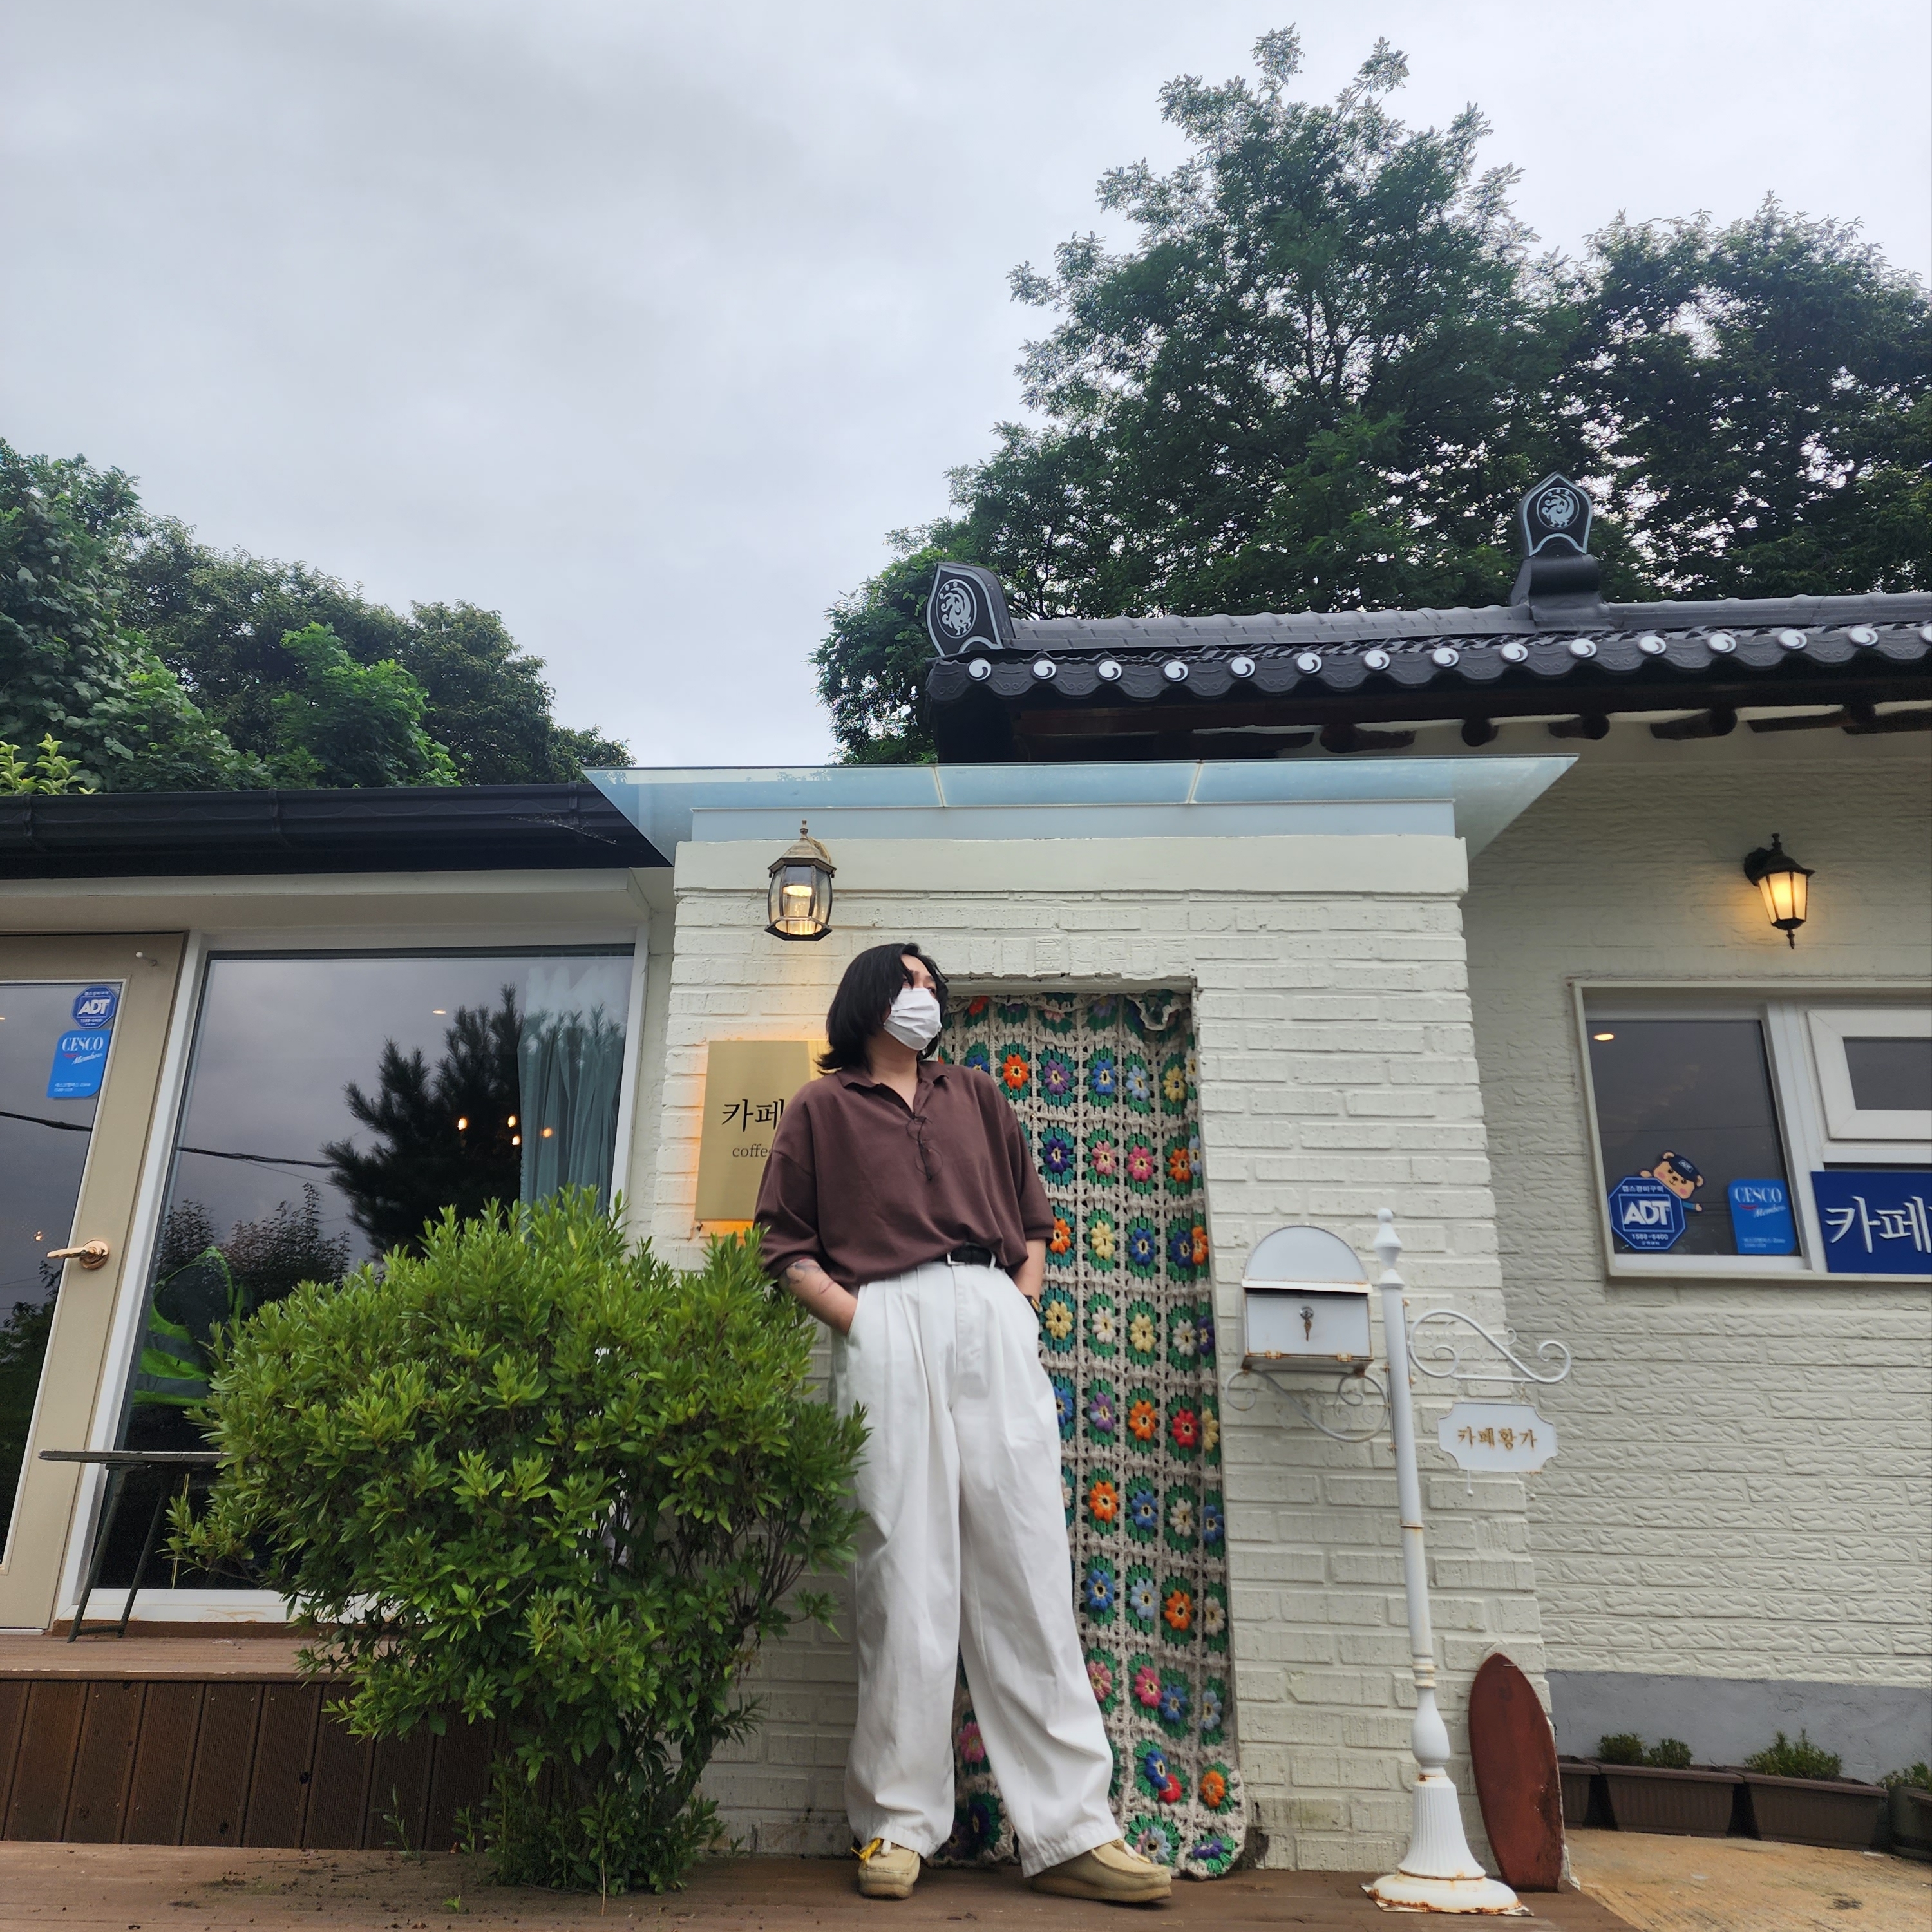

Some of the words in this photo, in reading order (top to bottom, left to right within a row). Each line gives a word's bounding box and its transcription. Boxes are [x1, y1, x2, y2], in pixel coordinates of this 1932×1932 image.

[77, 999, 110, 1015] ADT
[62, 1037, 104, 1052] CESCO
[1734, 1187, 1783, 1203] CESCO
[1624, 1200, 1671, 1226] ADT
[1825, 1195, 1932, 1254] 카페
